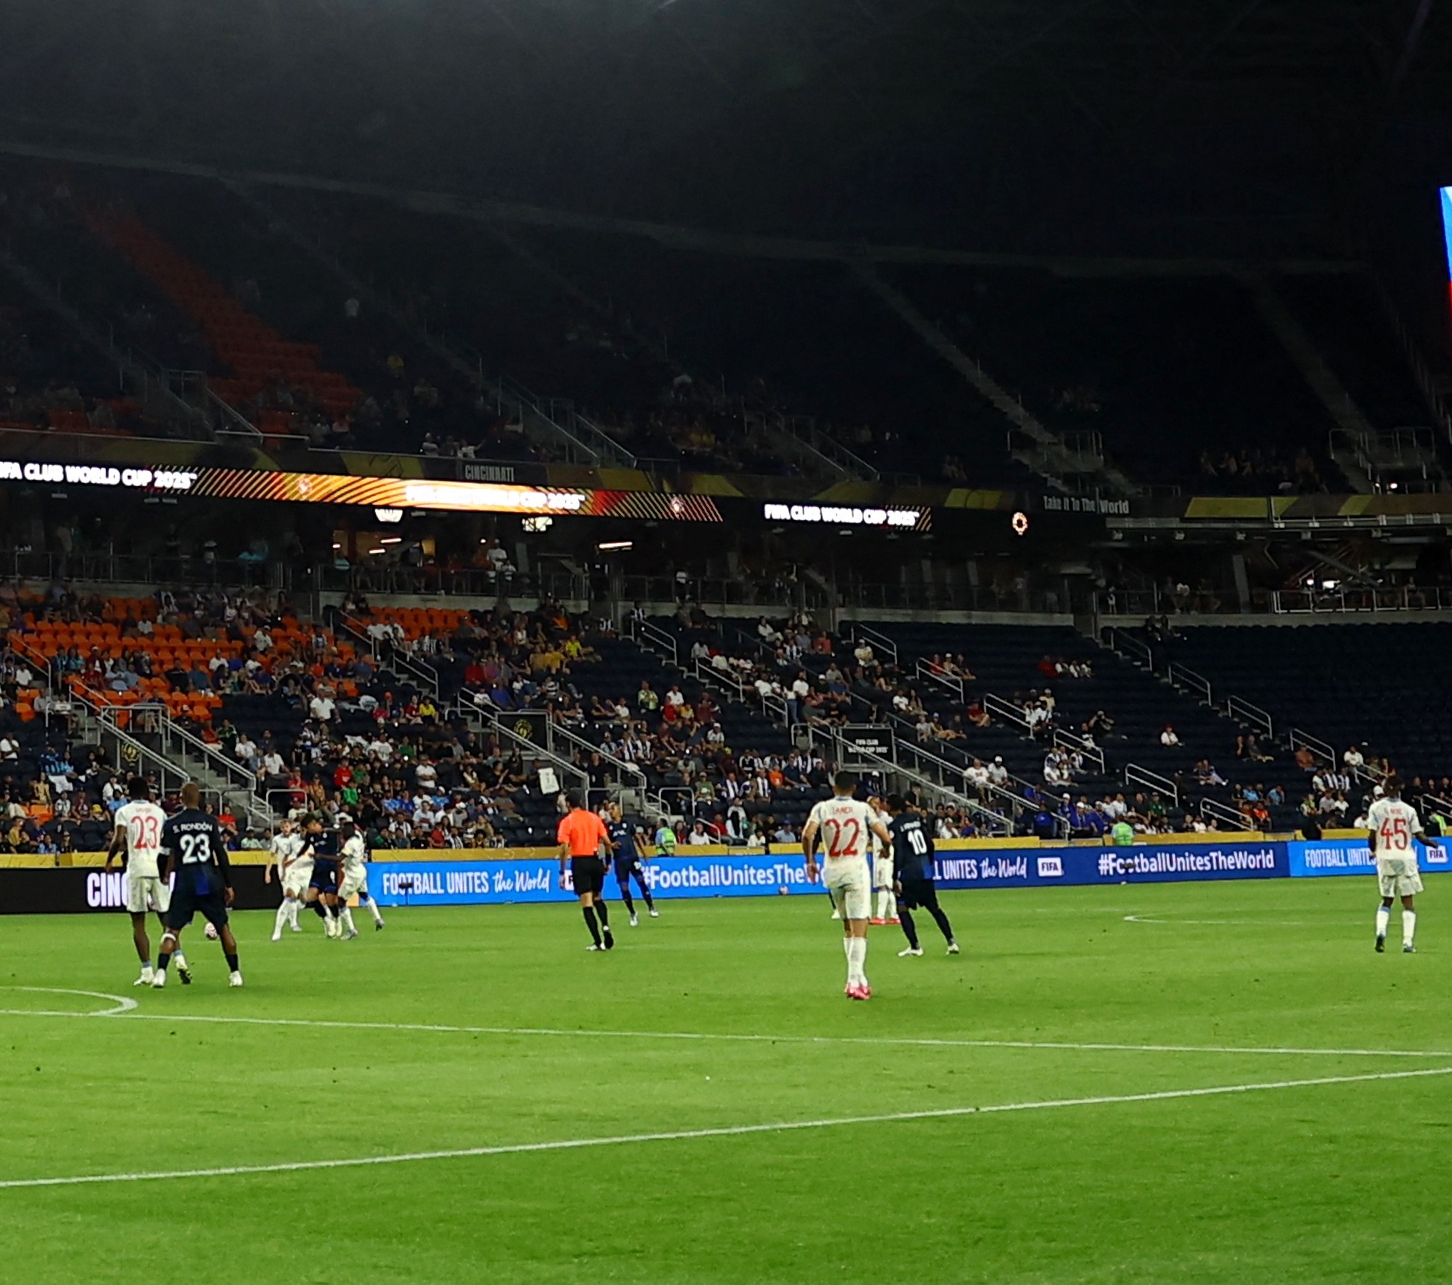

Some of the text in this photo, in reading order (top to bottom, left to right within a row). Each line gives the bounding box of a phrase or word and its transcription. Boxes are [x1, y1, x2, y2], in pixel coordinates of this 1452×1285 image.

[23, 462, 65, 483] CLUB
[65, 465, 121, 486] WORLD
[122, 468, 153, 487] CUP
[465, 464, 514, 482] CINCINNATI
[1099, 499, 1130, 514] World
[130, 815, 159, 850] 23
[181, 822, 213, 832] RONDÓN
[824, 817, 860, 858] 22
[1380, 817, 1408, 851] 45
[179, 833, 211, 864] 23
[907, 829, 928, 856] 10
[1428, 849, 1445, 859] FIFA
[943, 858, 976, 880] UNITES
[978, 857, 996, 878] the
[996, 855, 1029, 879] World
[1041, 861, 1061, 874] FIFA
[1098, 848, 1275, 876] #FootballUnitesTheWorld
[1305, 848, 1347, 868] FOOTBALL
[383, 867, 550, 896] FOOTBALL UNITES the World
